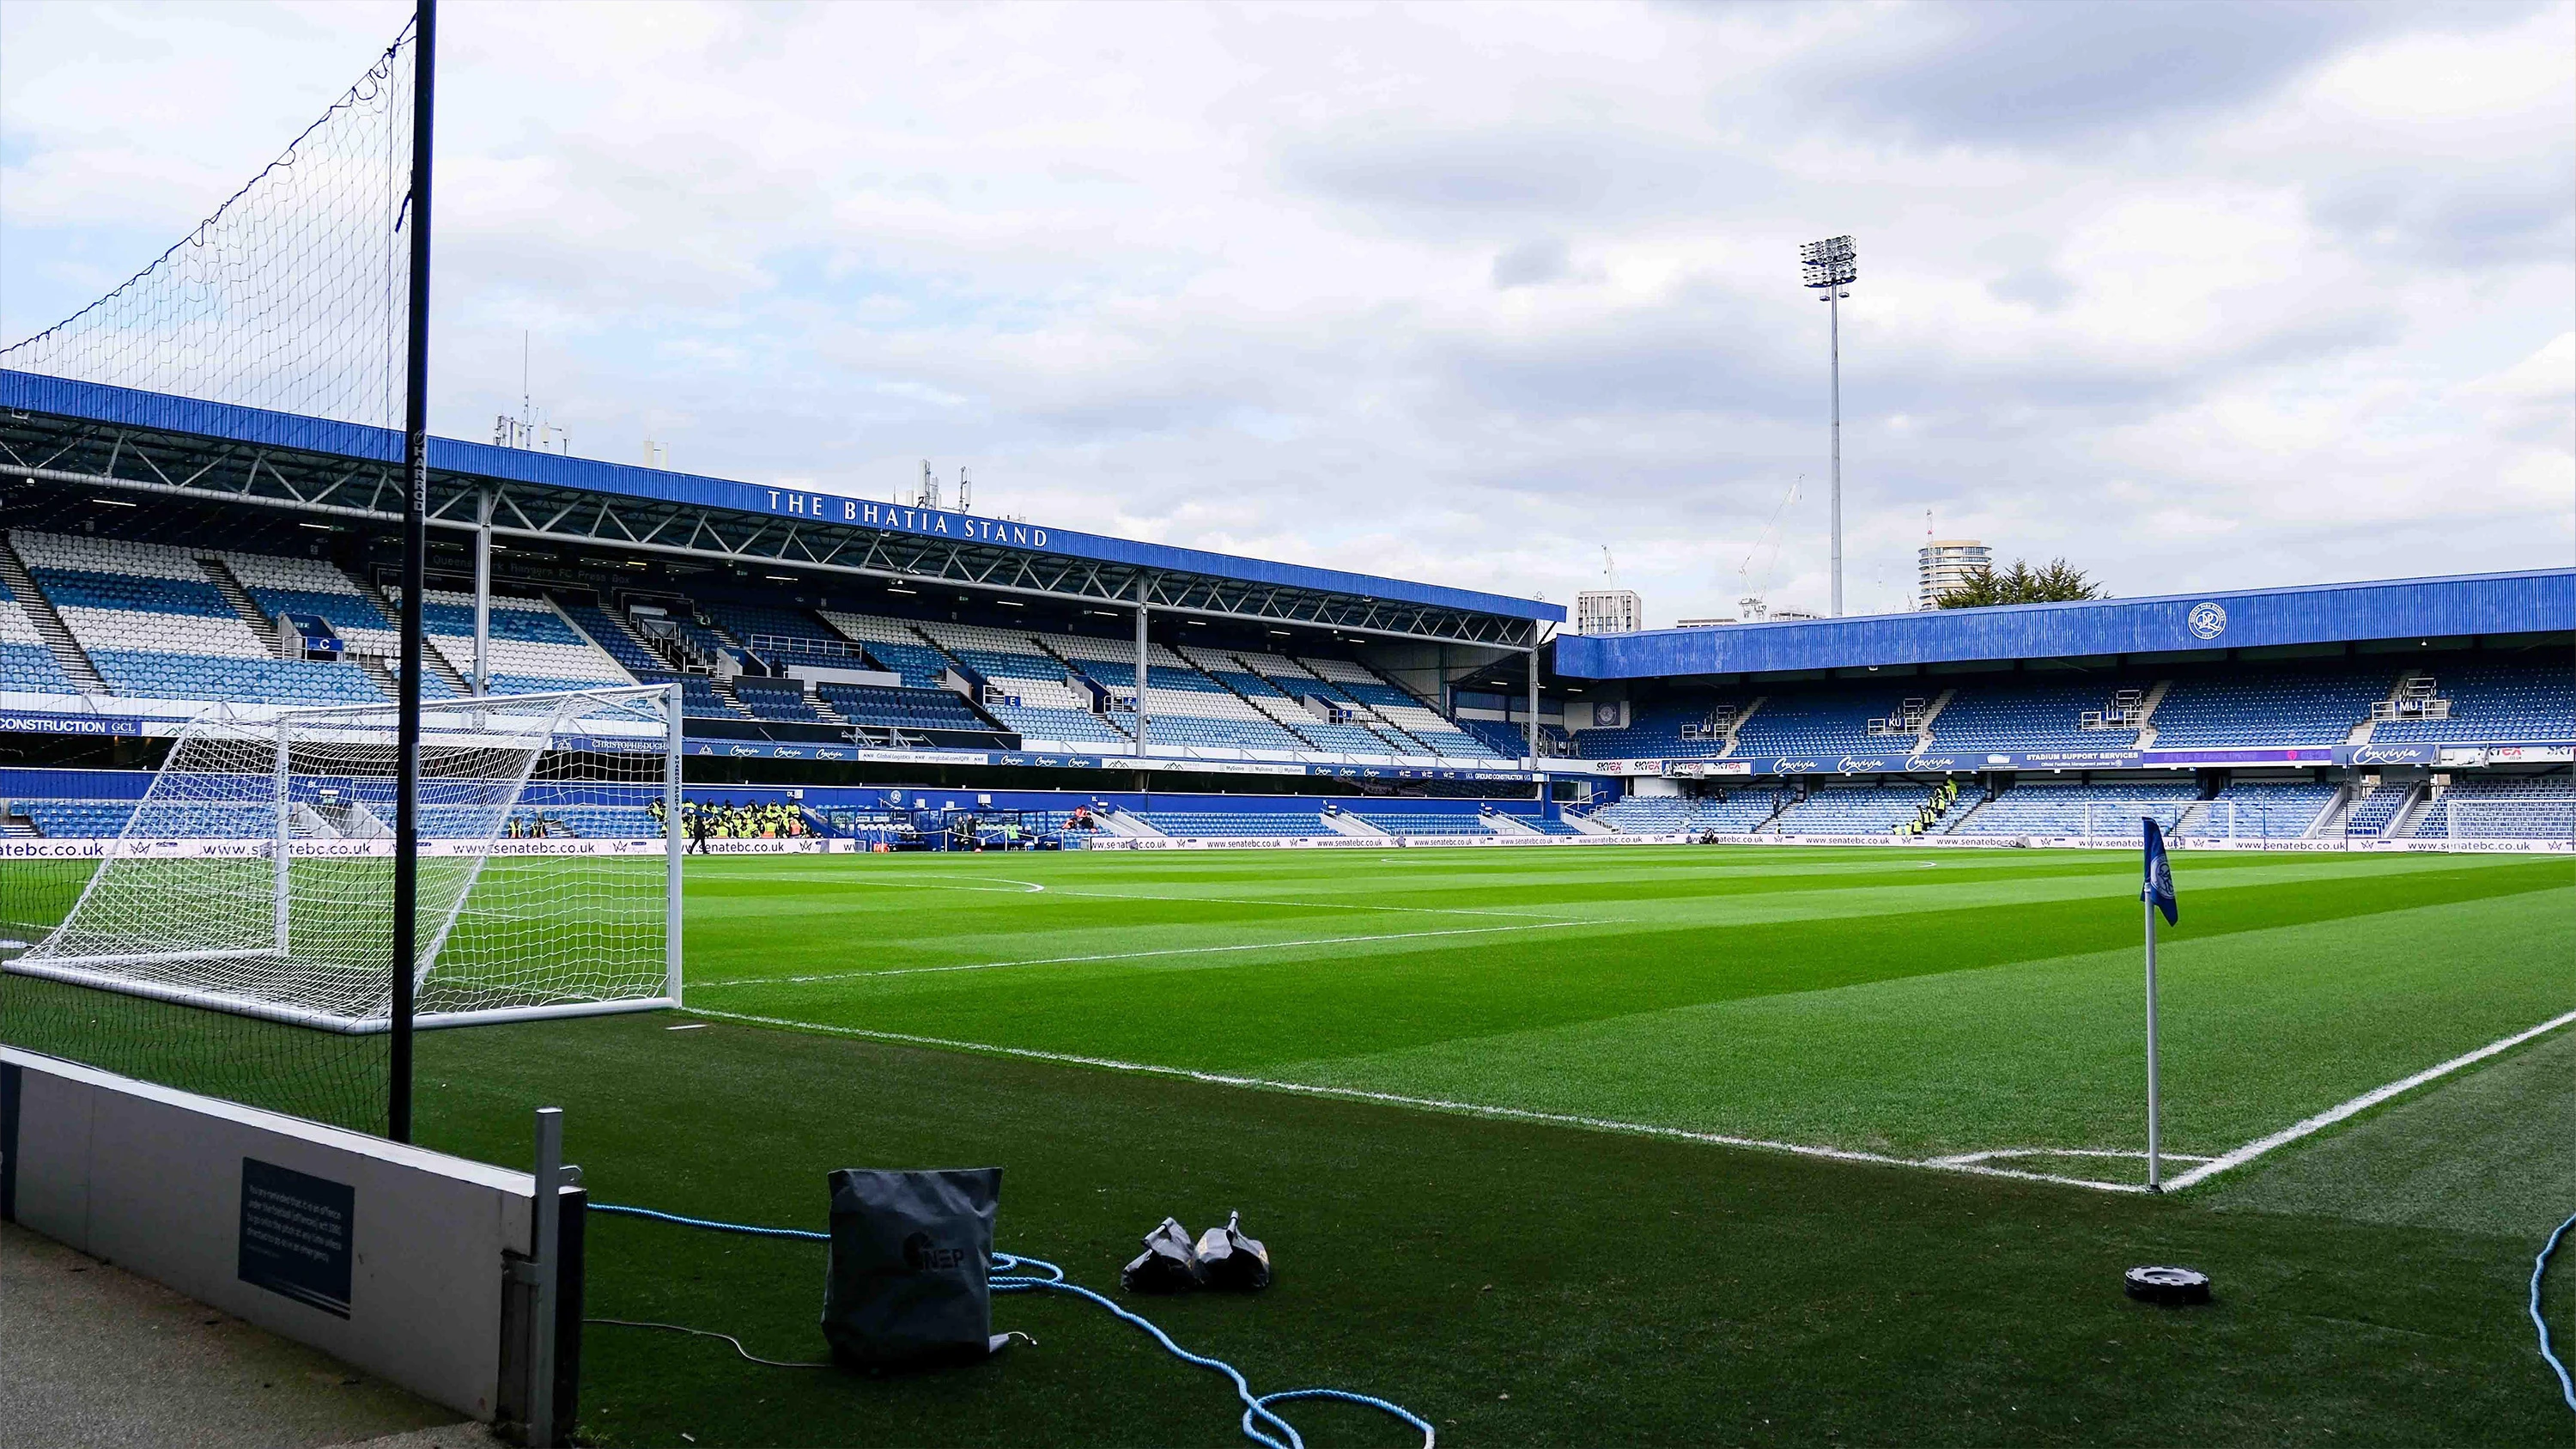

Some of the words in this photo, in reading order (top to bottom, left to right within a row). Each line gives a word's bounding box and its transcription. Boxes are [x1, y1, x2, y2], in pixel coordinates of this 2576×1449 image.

[769, 490, 823, 516] THE
[845, 500, 948, 534] BHATIA
[965, 519, 1048, 548] STAND
[319, 639, 331, 649] C
[1010, 697, 1016, 705] E
[2399, 701, 2418, 711] MU
[0, 718, 106, 733] CONSTRUCTION
[111, 722, 136, 733] GCL
[1700, 723, 1711, 733] JU
[1888, 718, 1902, 728] KU
[2352, 745, 2422, 764] Convivia
[1772, 757, 1818, 773] Convivia
[1837, 756, 1884, 772] Convivia
[1905, 754, 1955, 771] Convivia
[1206, 839, 1281, 849] www.senatebc.co.uk
[1316, 838, 1382, 847] www.senatebc.co.uk
[1414, 837, 1473, 846] www.senatebc.co.uk
[1500, 837, 1553, 845] www.senatebc.co.uk
[1578, 836, 1643, 844] www.senatebc.co.uk
[1806, 837, 1890, 845] www.senatebc.co.uk
[2235, 840, 2345, 850] www.senatebc.co.uk
[924, 1248, 963, 1269] NEP
